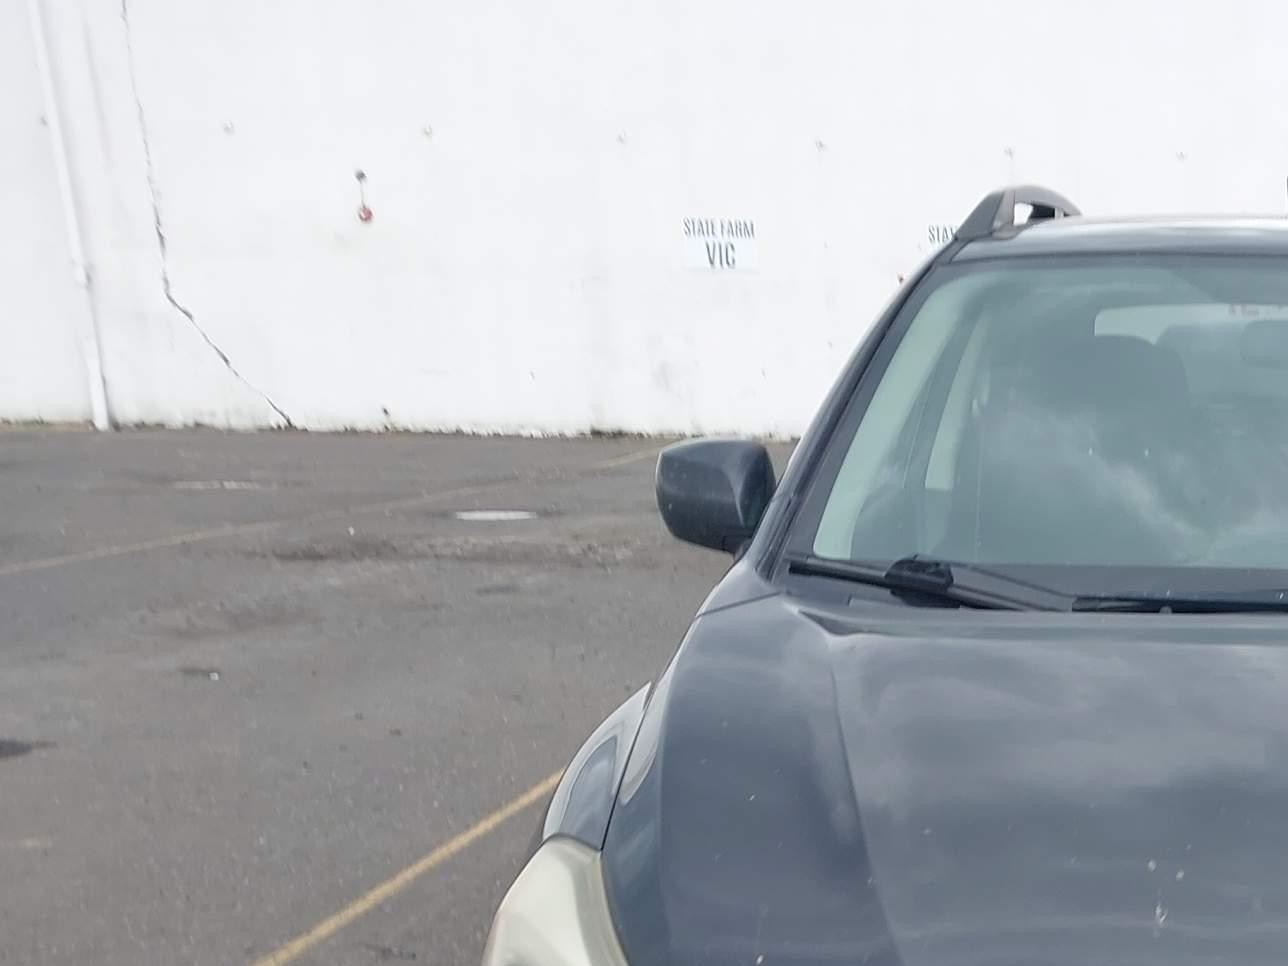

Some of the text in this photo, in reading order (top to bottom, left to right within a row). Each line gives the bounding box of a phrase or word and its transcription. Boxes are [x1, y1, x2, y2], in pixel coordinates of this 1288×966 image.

[683, 217, 756, 239] STATE FARM
[704, 240, 736, 269] VIC
